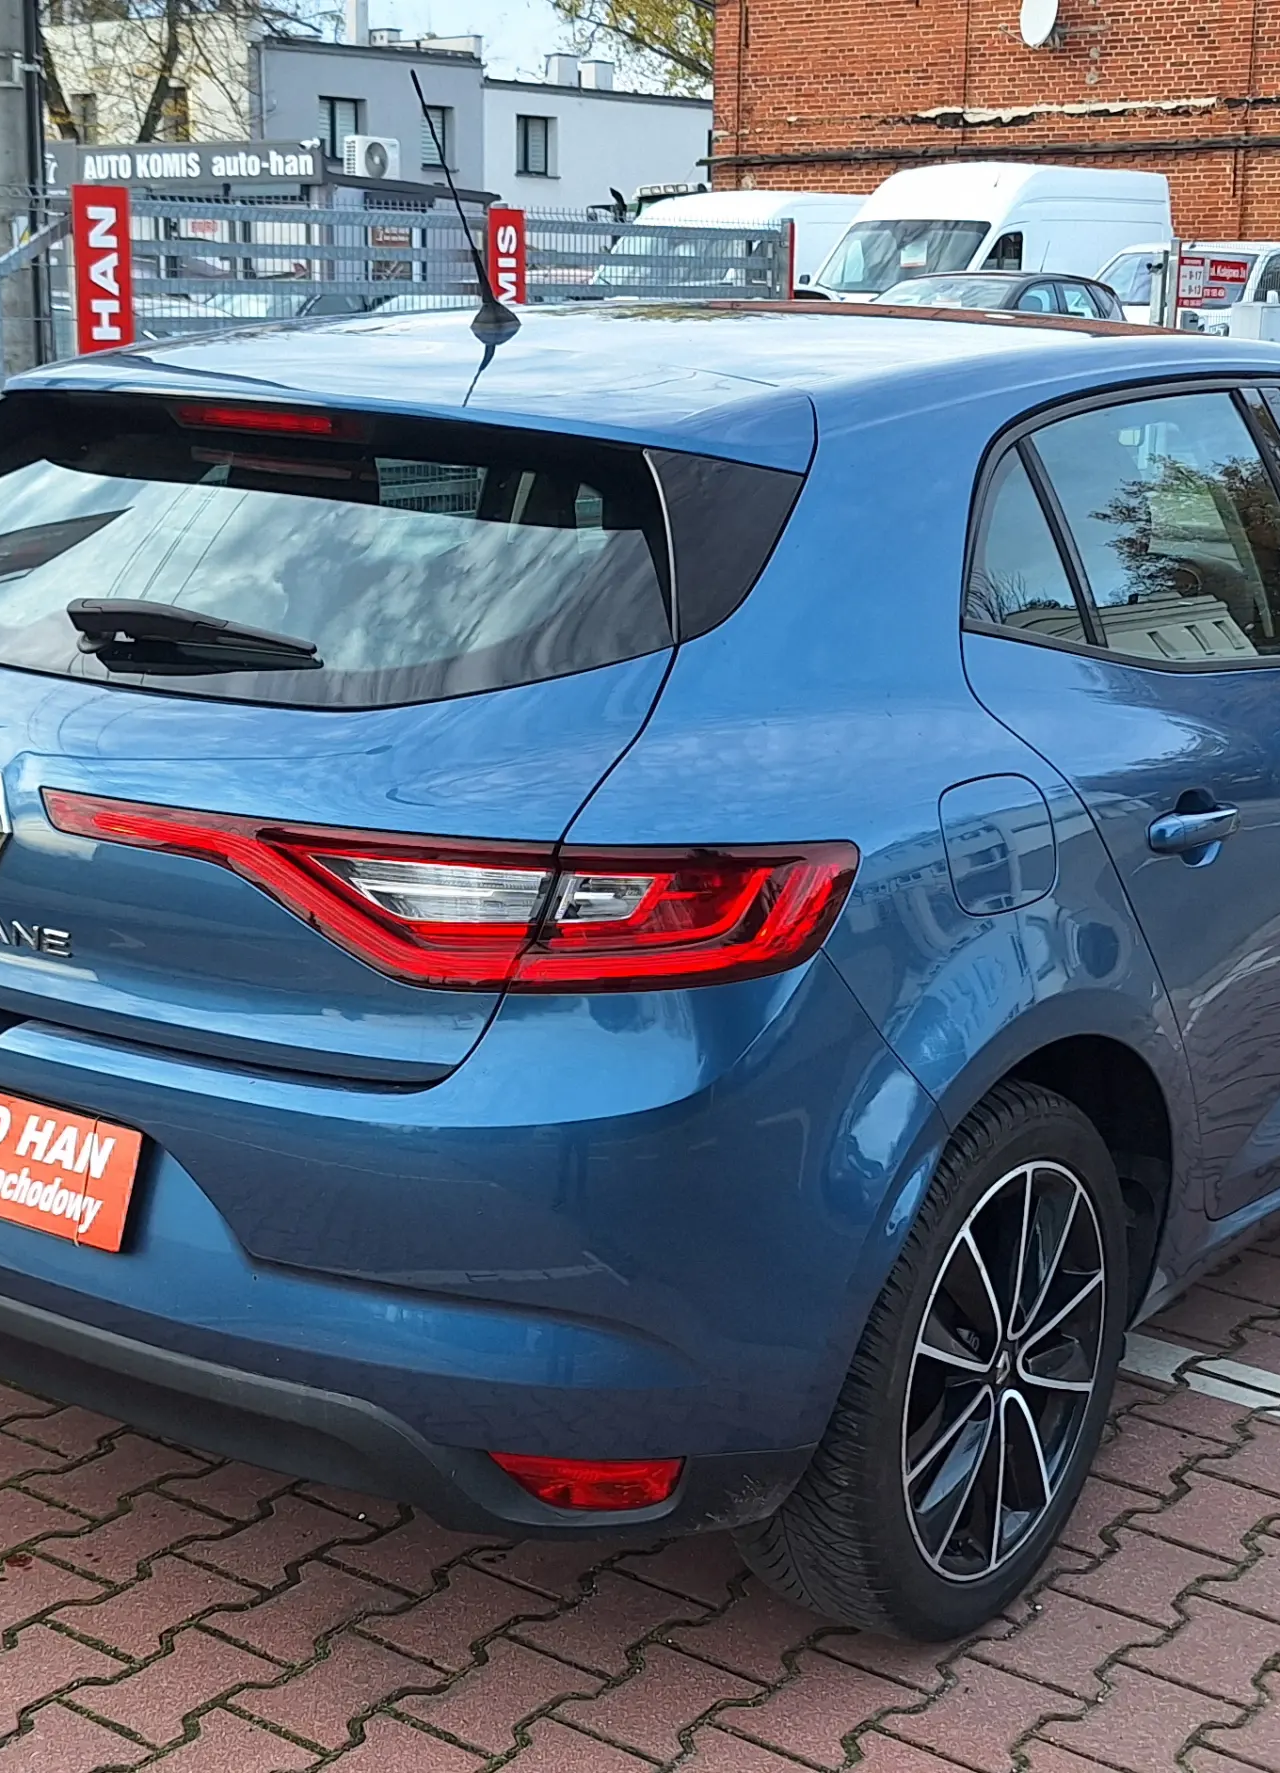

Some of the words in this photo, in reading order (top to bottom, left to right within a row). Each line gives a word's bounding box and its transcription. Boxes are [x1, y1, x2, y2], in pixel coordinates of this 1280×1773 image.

[84, 154, 132, 180] AUTO
[136, 152, 201, 178] KOMIS
[212, 150, 314, 176] auto-han
[86, 205, 122, 341] HAN
[497, 225, 518, 305] MIS
[16, 1115, 116, 1180] HAN
